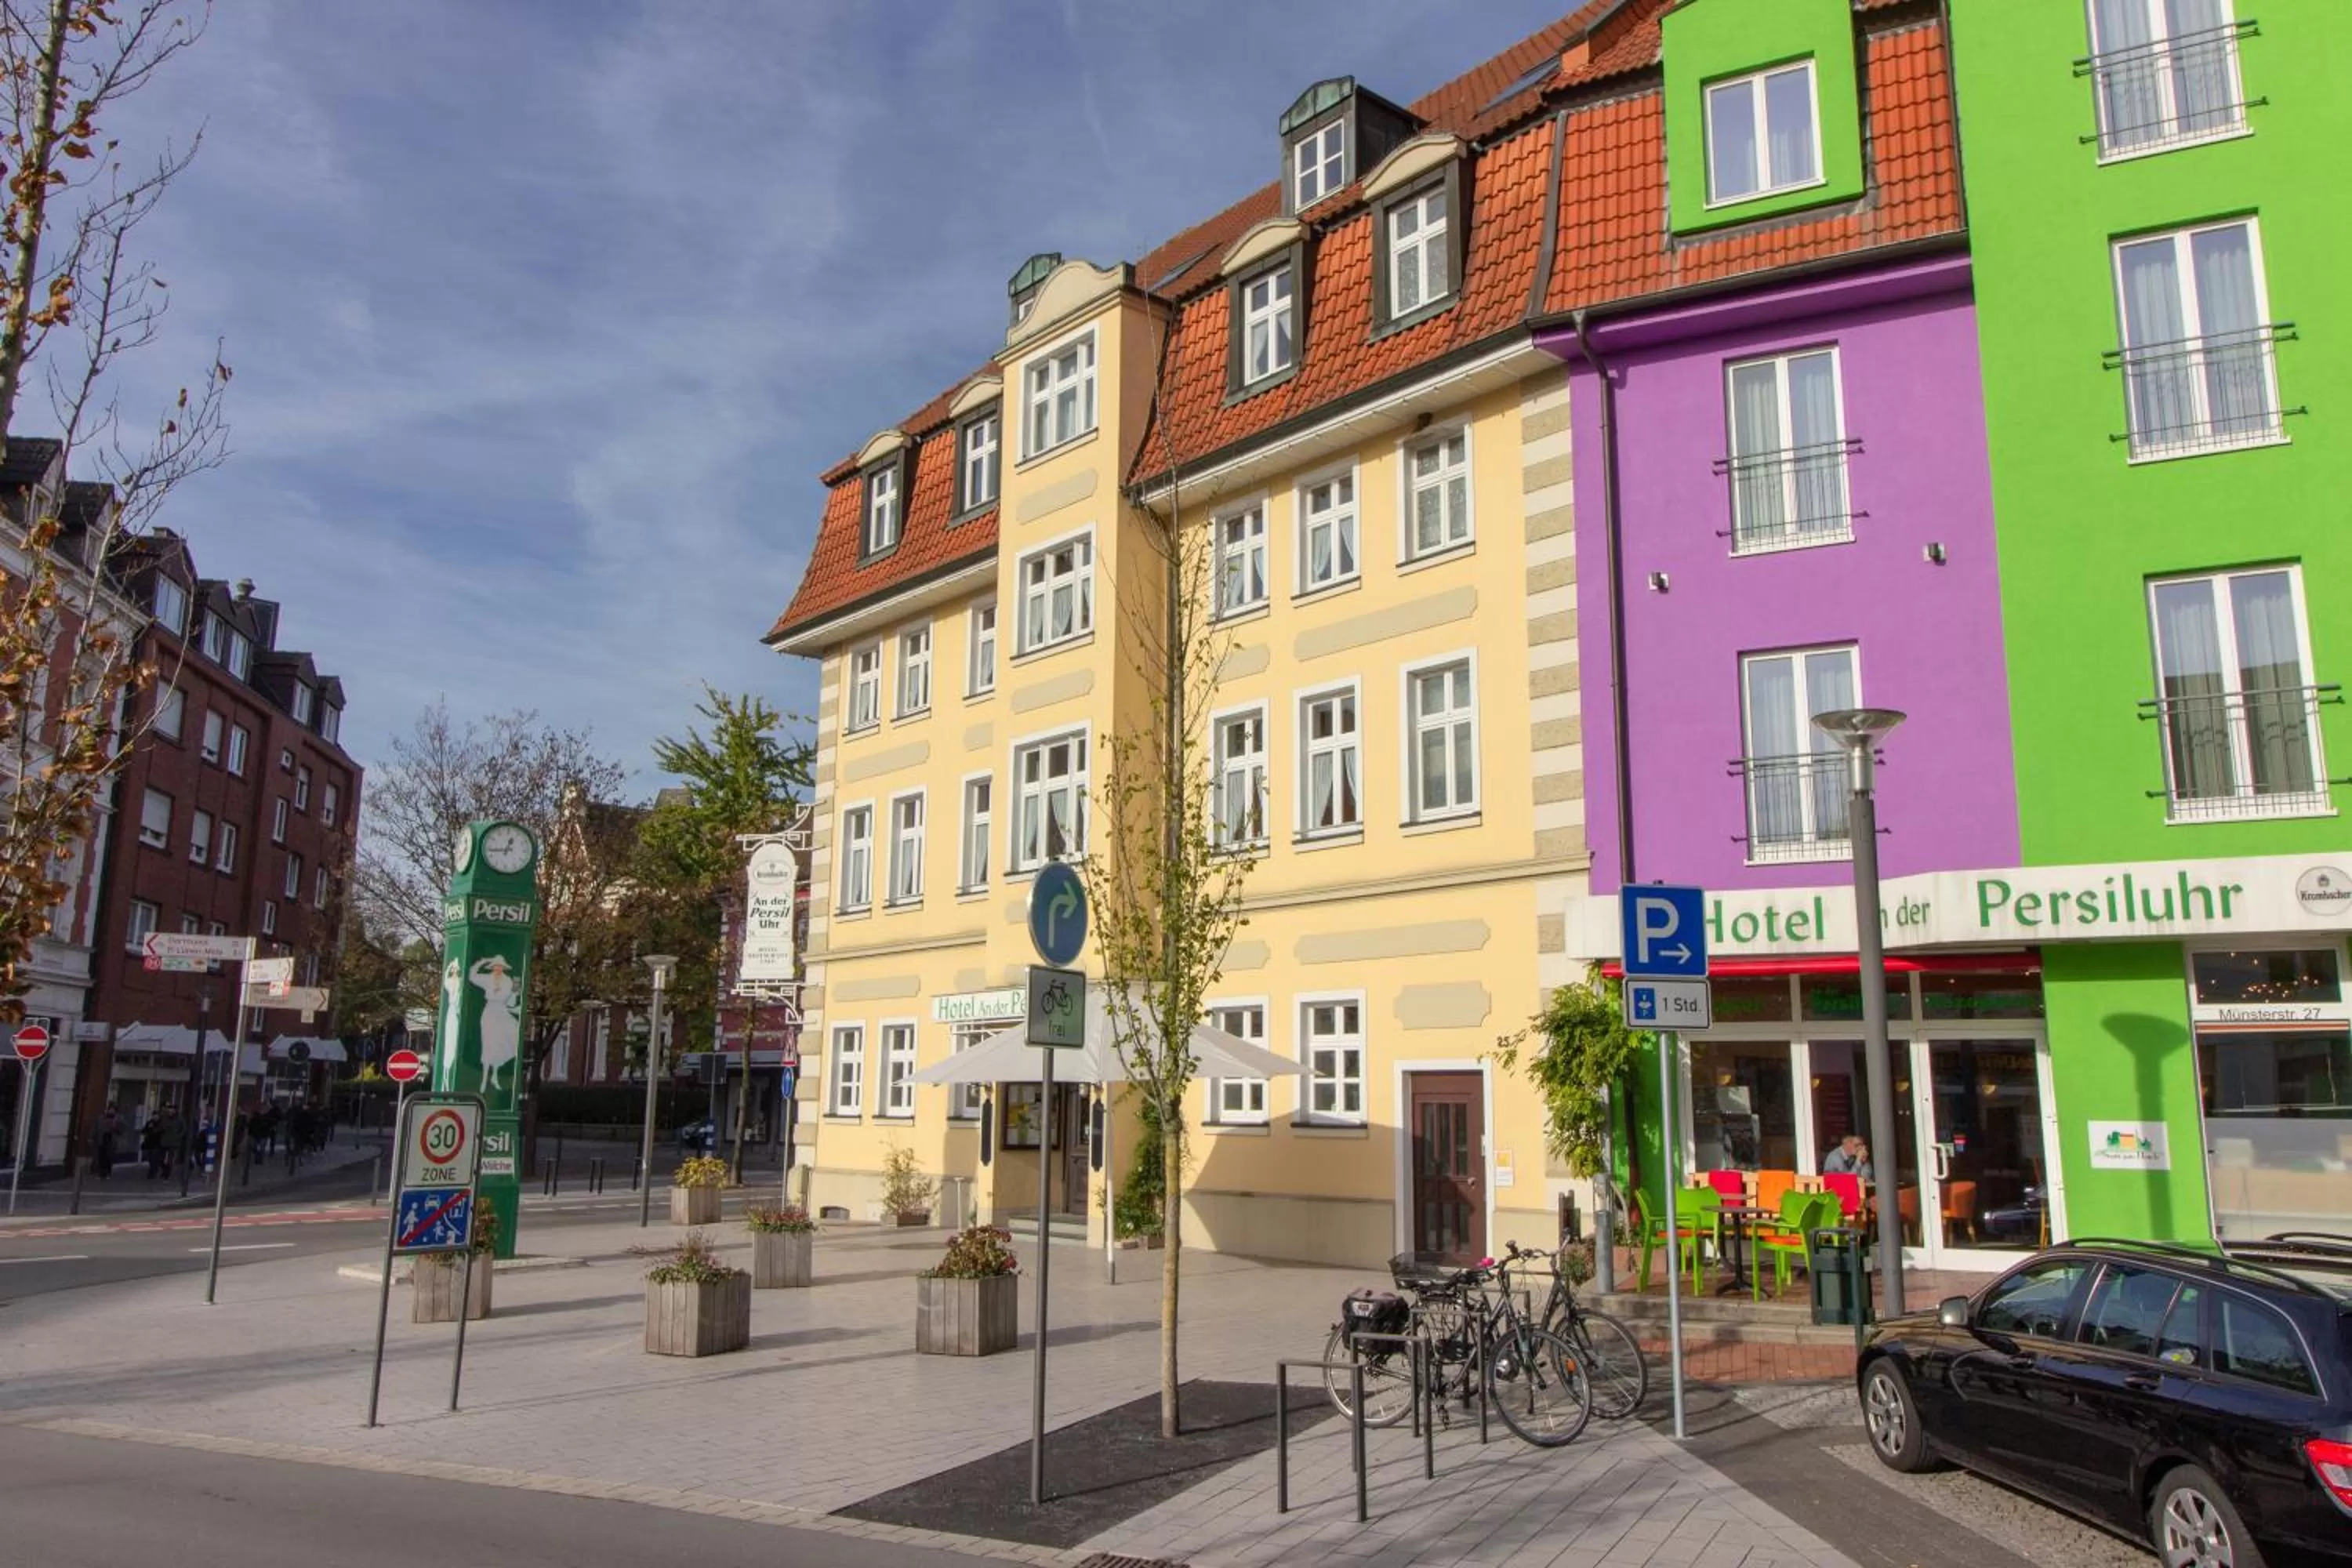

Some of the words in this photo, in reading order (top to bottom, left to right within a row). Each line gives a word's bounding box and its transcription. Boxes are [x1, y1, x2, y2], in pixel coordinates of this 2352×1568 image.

[753, 897, 768, 906] An
[771, 897, 787, 906] der
[1977, 870, 2243, 927] Persiluhr
[473, 898, 532, 923] Persil
[750, 906, 791, 918] Persil
[759, 920, 779, 929] Uhr
[1705, 896, 1824, 943] Hotel
[1896, 896, 1930, 927] der
[1636, 897, 1679, 963] P
[938, 996, 975, 1019] Hotel
[1663, 997, 1668, 1012] 1
[1674, 996, 1703, 1013] Std.
[2303, 1007, 2321, 1020] 27
[1048, 1021, 1065, 1038] frei
[1497, 1036, 1510, 1048] 25
[429, 1124, 456, 1149] 30
[421, 1167, 457, 1182] ZONE
